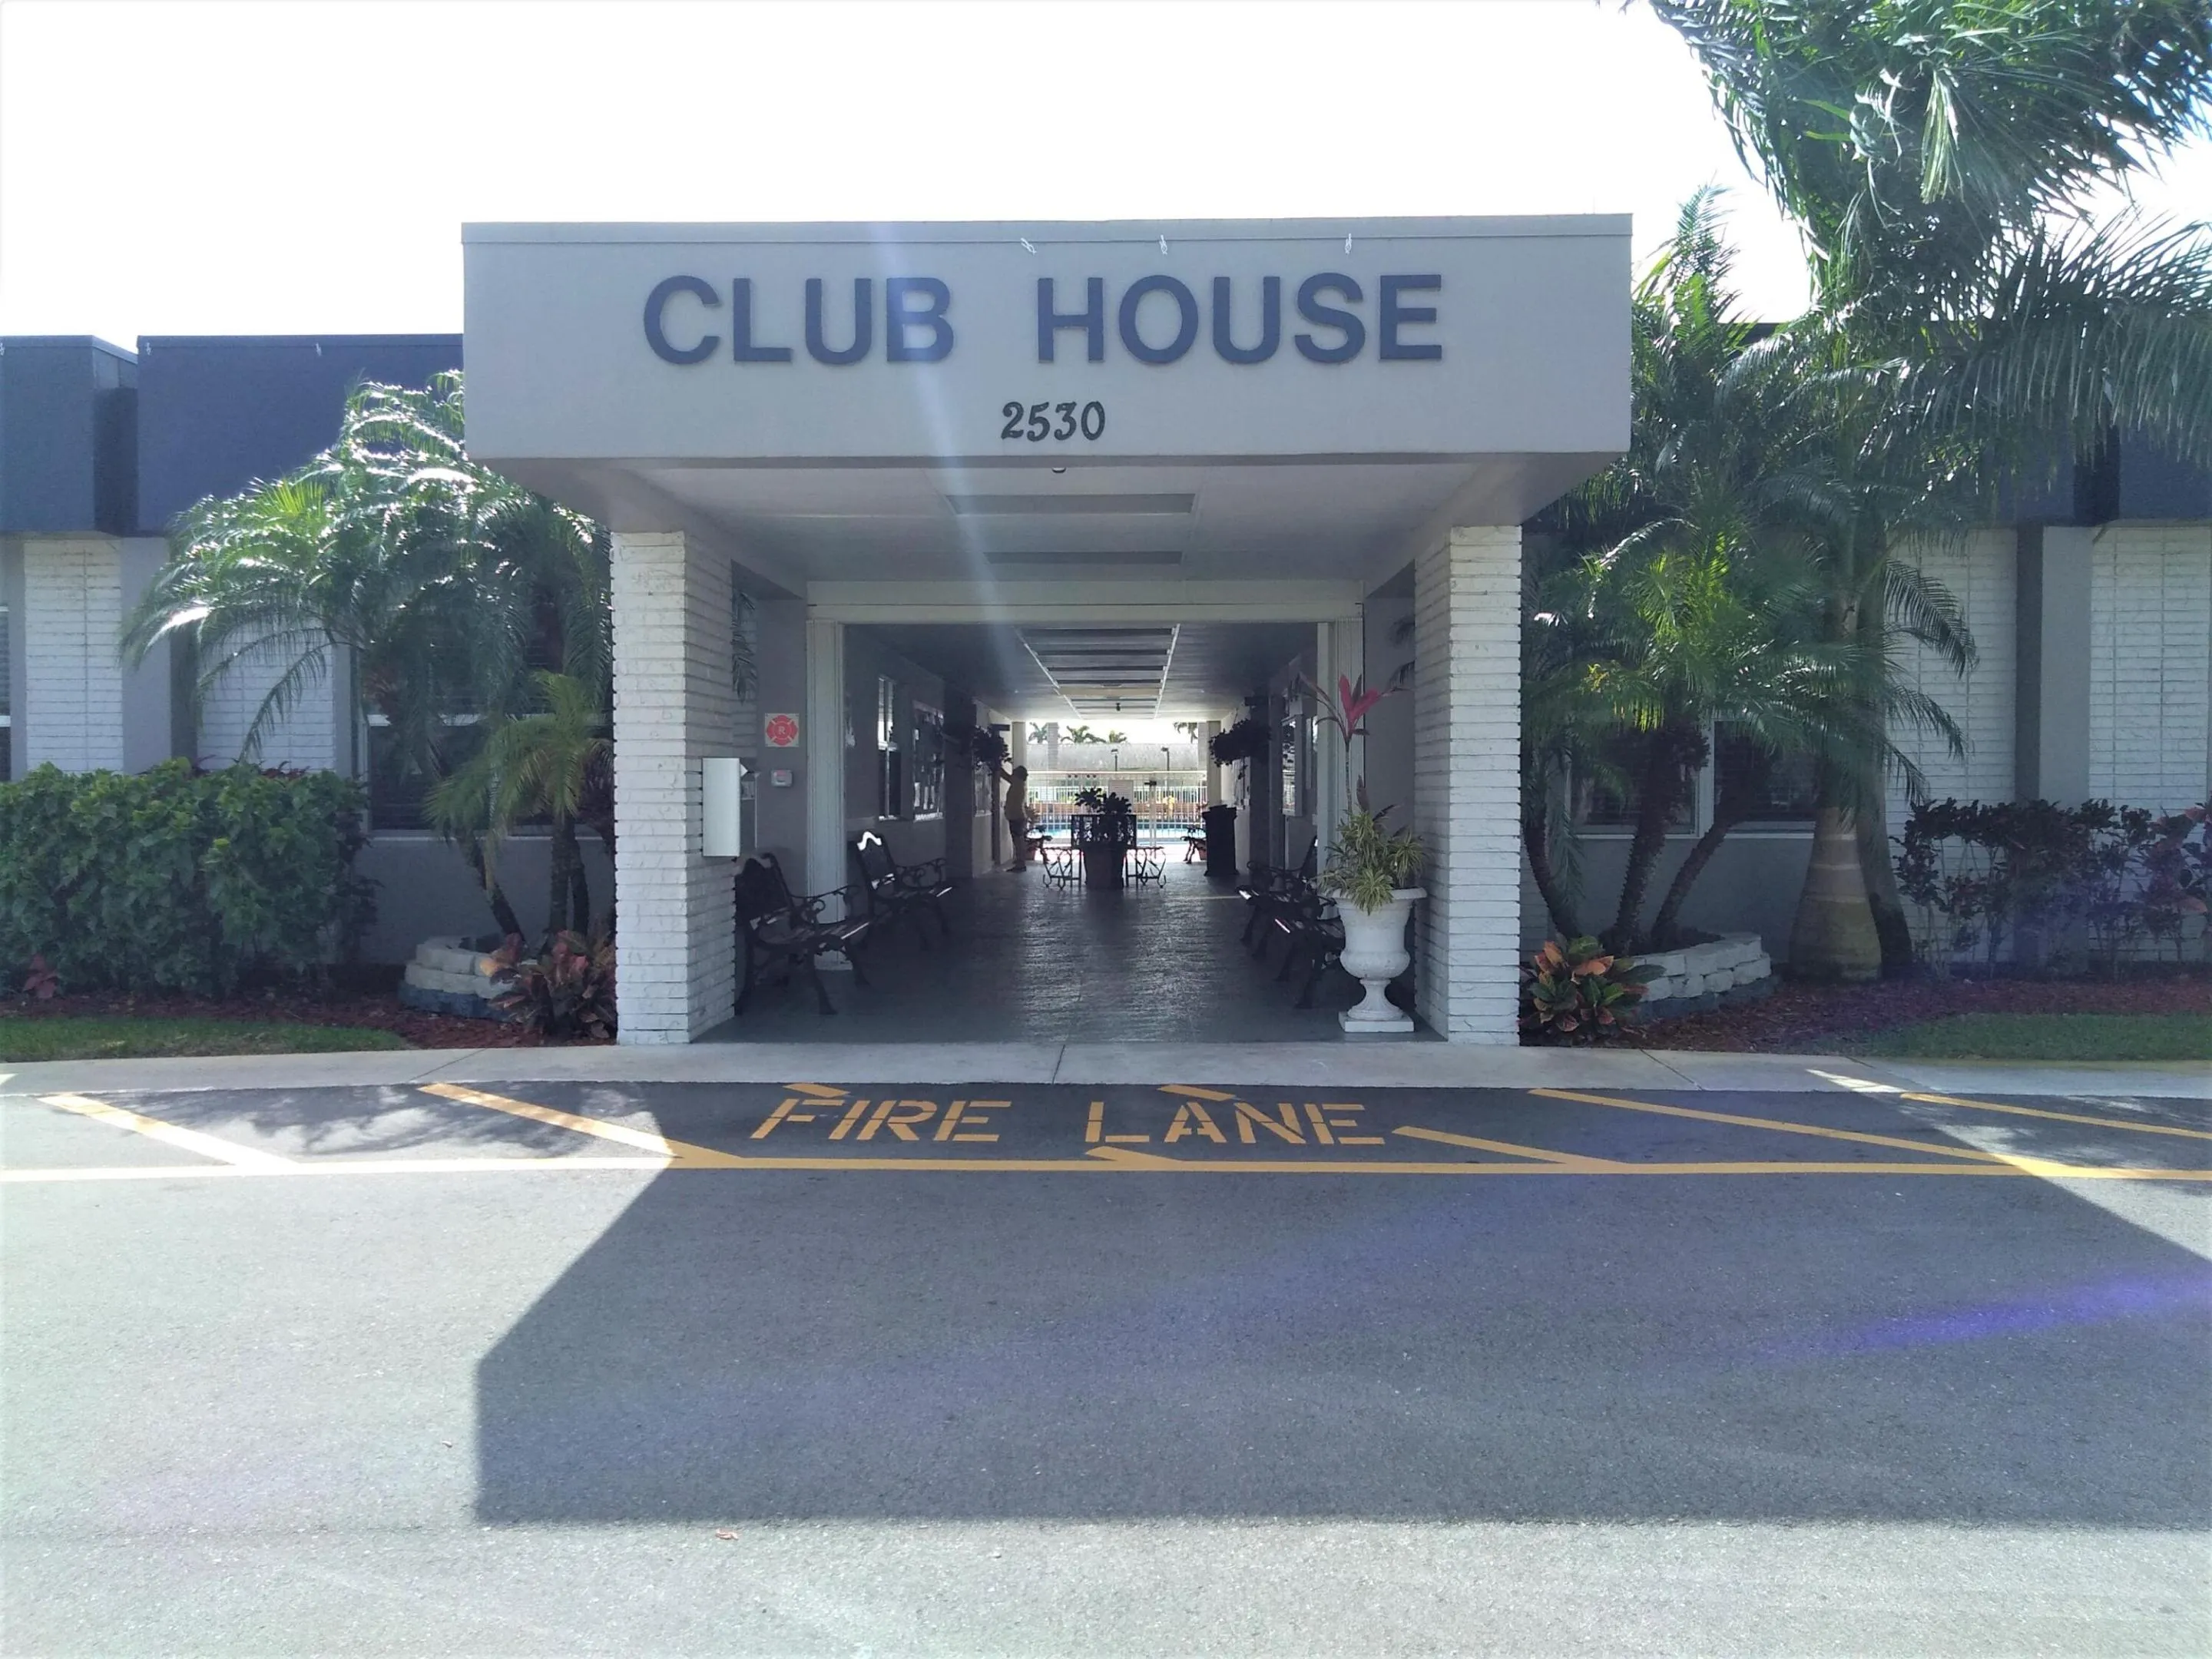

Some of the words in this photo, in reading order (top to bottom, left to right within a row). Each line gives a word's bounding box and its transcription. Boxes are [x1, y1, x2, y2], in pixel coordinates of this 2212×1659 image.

[643, 274, 955, 367] CLUB
[1037, 272, 1443, 367] HOUSE
[1000, 400, 1106, 442] 2530
[750, 1098, 1012, 1142] FIRE
[1084, 1101, 1386, 1145] LANE
